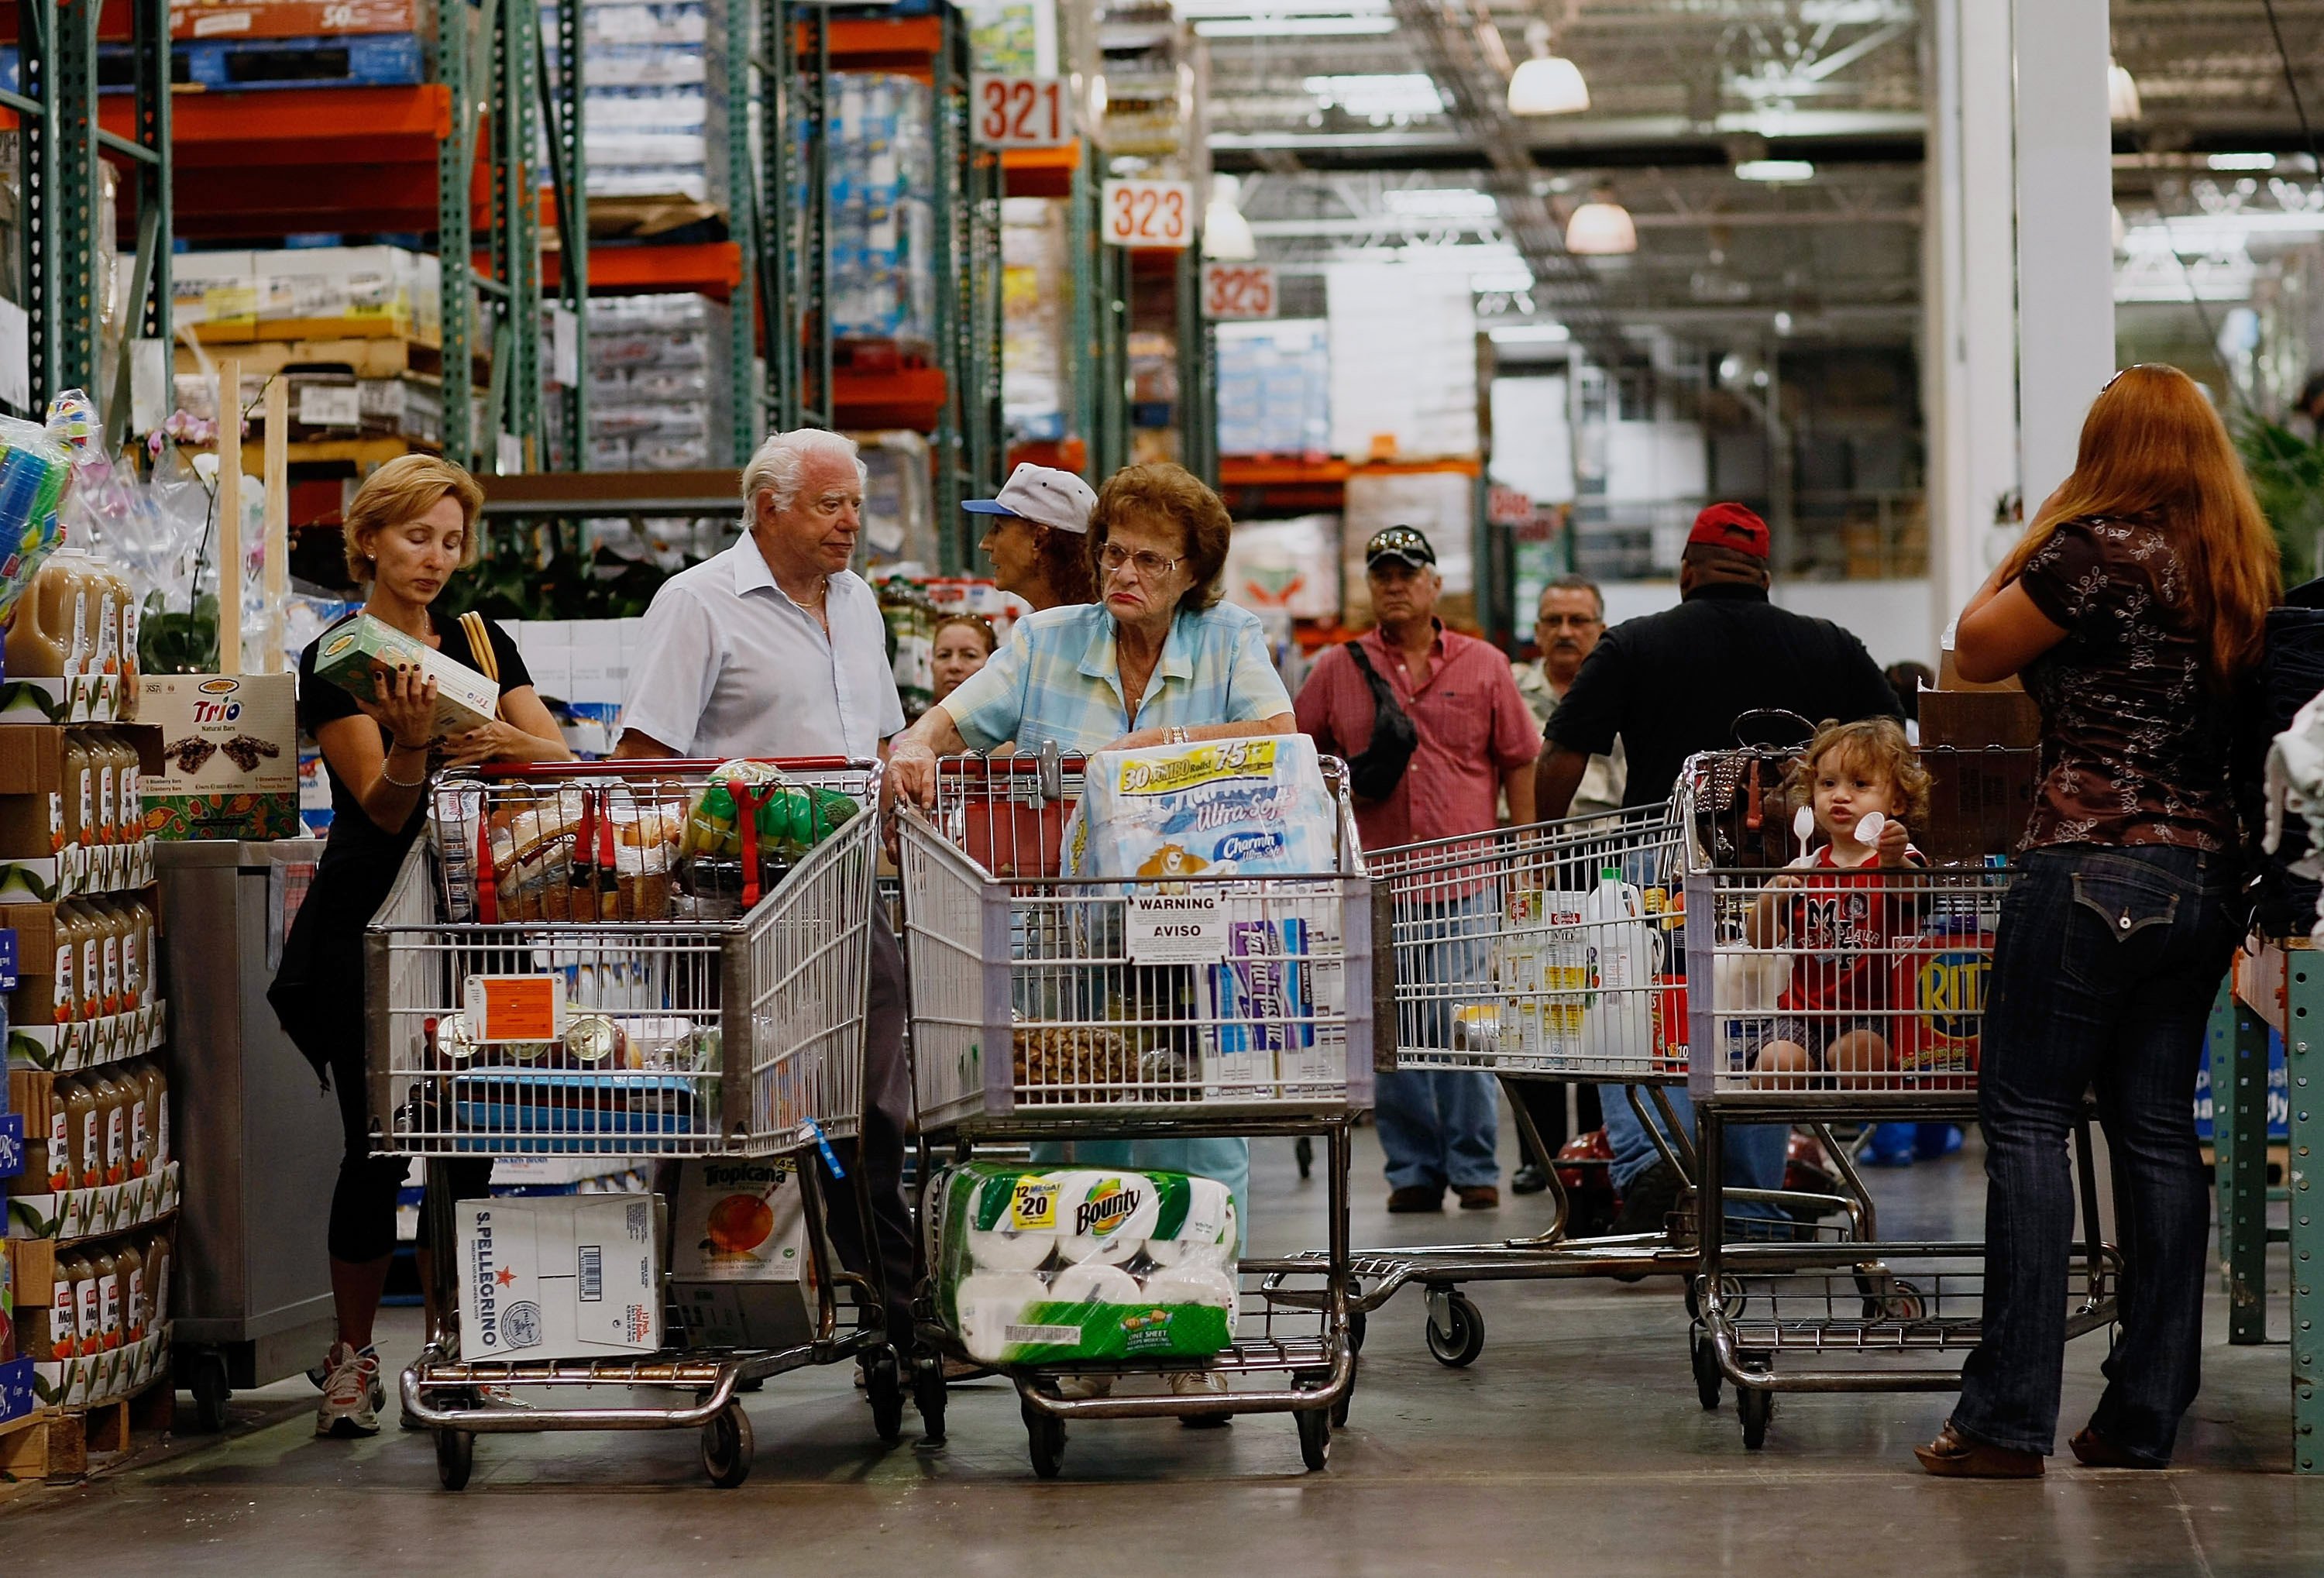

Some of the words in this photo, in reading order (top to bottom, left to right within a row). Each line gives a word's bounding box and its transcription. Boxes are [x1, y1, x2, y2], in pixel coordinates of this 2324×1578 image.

[982, 80, 1061, 140] 321
[1114, 188, 1184, 238] 323
[1208, 268, 1272, 313] 325
[194, 696, 242, 724] Trio
[1122, 765, 1150, 791] 30
[1150, 758, 1190, 785] JUMBO
[1190, 760, 1211, 773] Rolls!
[1214, 741, 1248, 772] 75
[1196, 803, 1246, 833] Ultra
[1249, 786, 1292, 820] Soft
[1223, 832, 1275, 859] Charmin
[1140, 898, 1215, 910] WARNING
[1153, 925, 1202, 937] AVISO
[1301, 962, 1312, 1005] KIRKLAND
[703, 1163, 786, 1187] Tropicana
[1016, 1186, 1030, 1198] 12
[1074, 1184, 1140, 1237] Bounty
[476, 1211, 497, 1347] S.PELLEGRINO
[1145, 1329, 1168, 1338] SHEET
